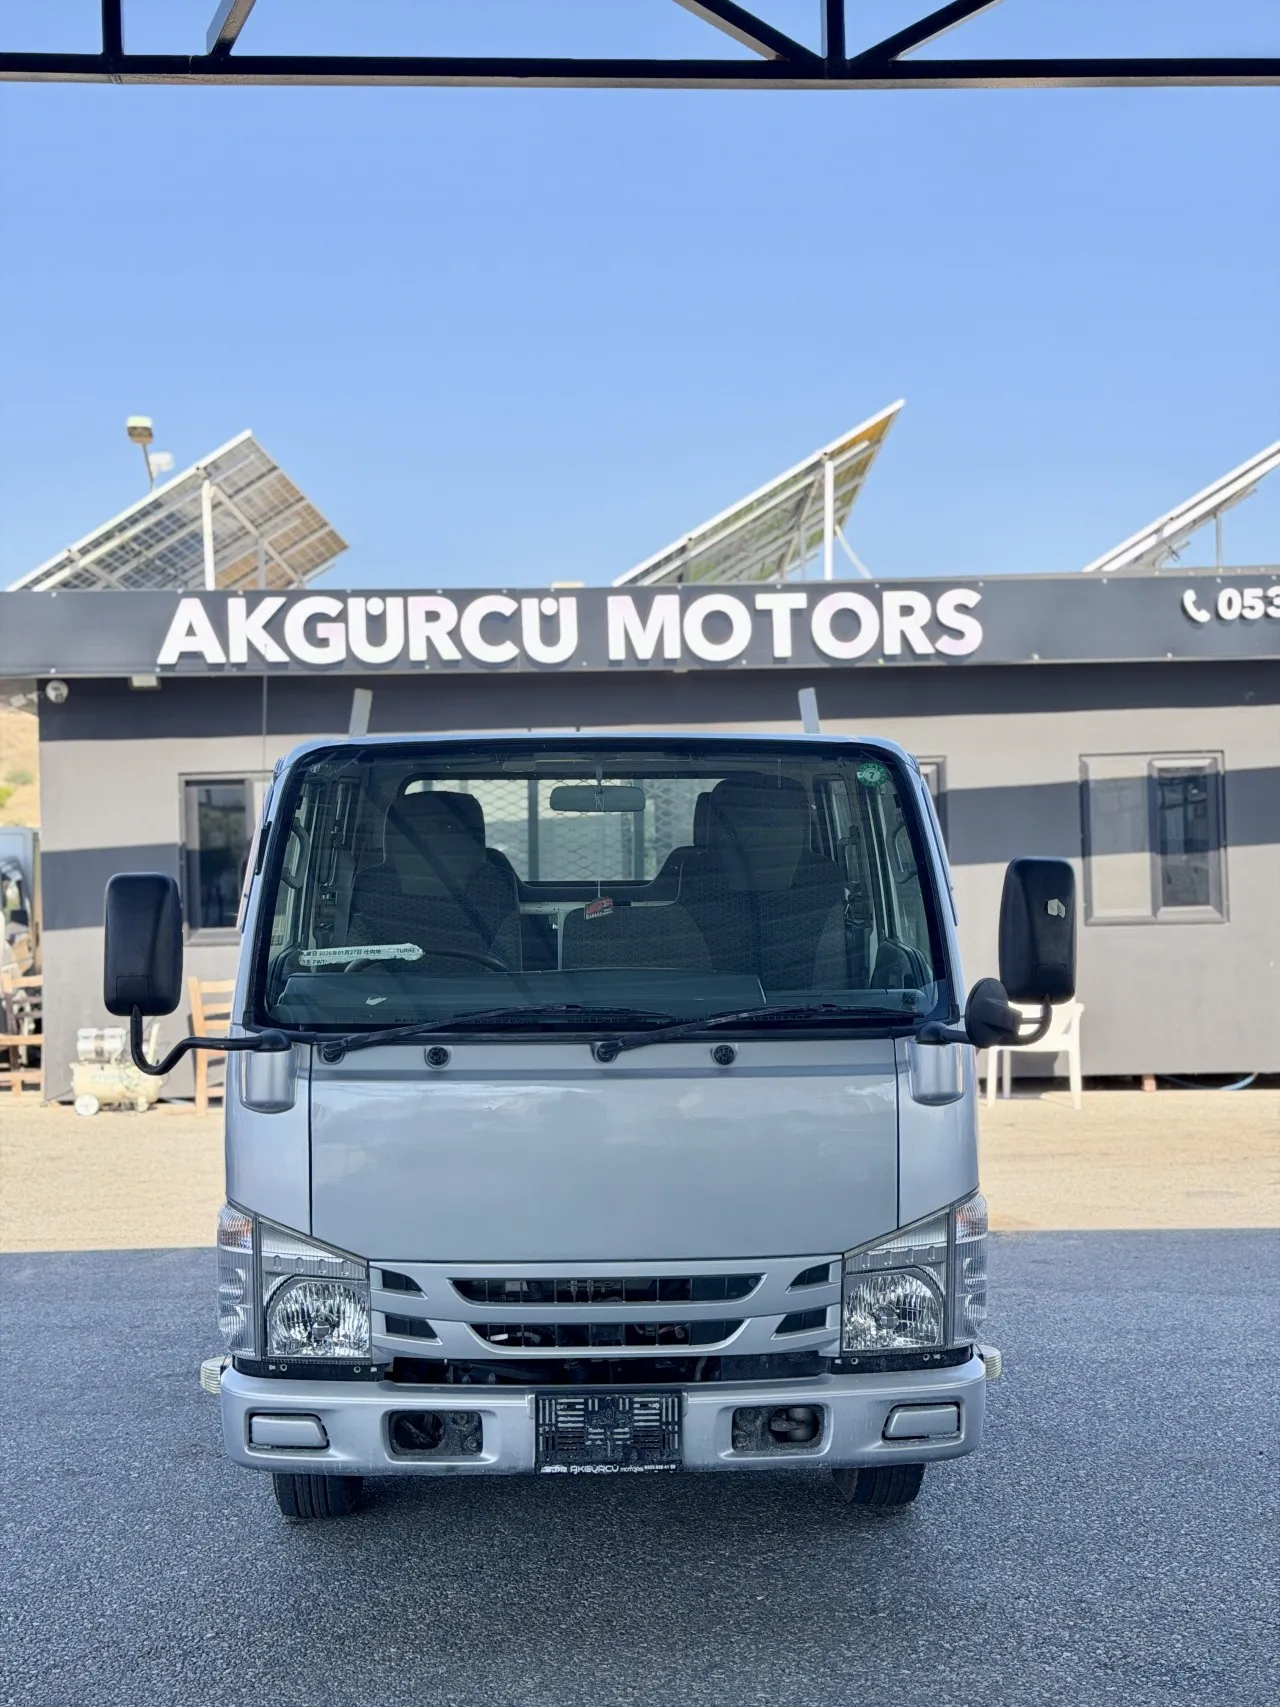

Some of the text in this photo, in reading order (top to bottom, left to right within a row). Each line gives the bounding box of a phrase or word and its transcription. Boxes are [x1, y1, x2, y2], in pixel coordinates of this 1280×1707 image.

[157, 588, 983, 665] AKGÜRCÜ MOTORS
[869, 771, 875, 779] 7
